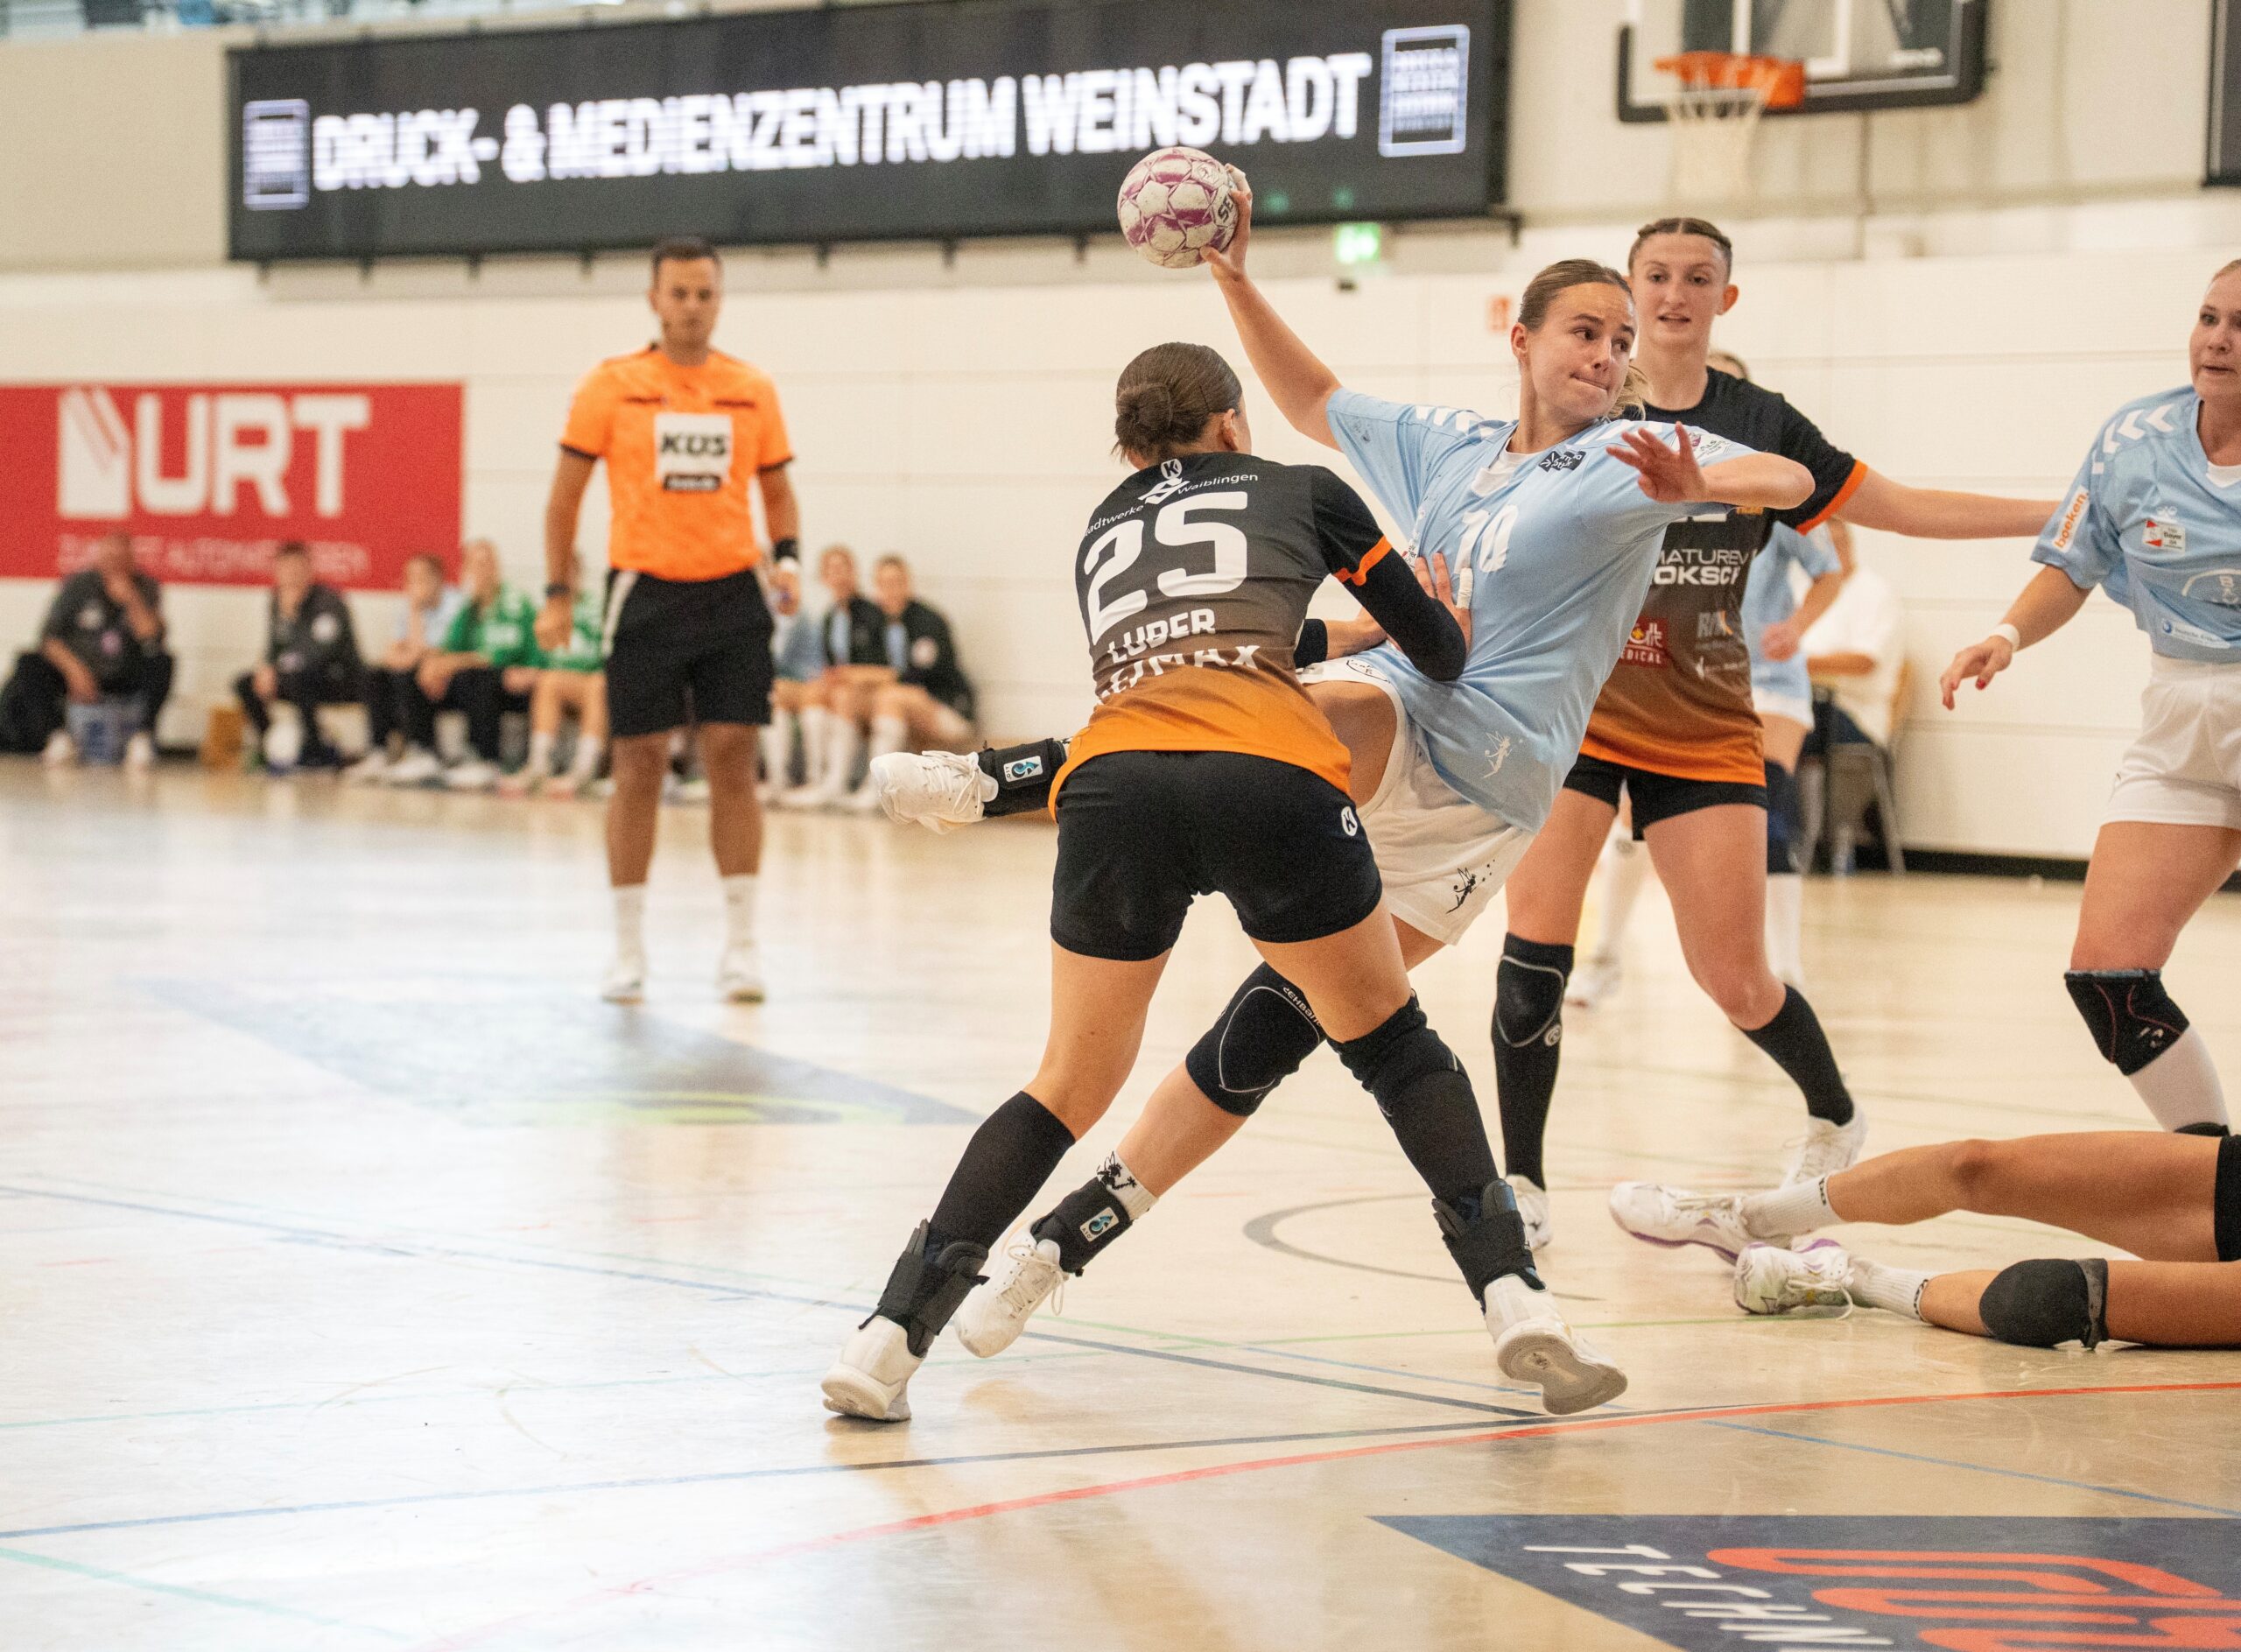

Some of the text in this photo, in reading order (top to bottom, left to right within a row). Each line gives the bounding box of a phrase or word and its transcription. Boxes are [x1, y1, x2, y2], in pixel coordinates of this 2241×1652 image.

[313, 107, 500, 191] DRUCK-
[501, 103, 547, 183] &
[548, 76, 1017, 180] MEDIENZENTRUM
[1022, 52, 1373, 155] WEINSTADT
[1177, 474, 1259, 495] Waiblingen
[1084, 490, 1248, 646] 25
[1521, 1543, 1900, 1652] TECHN
